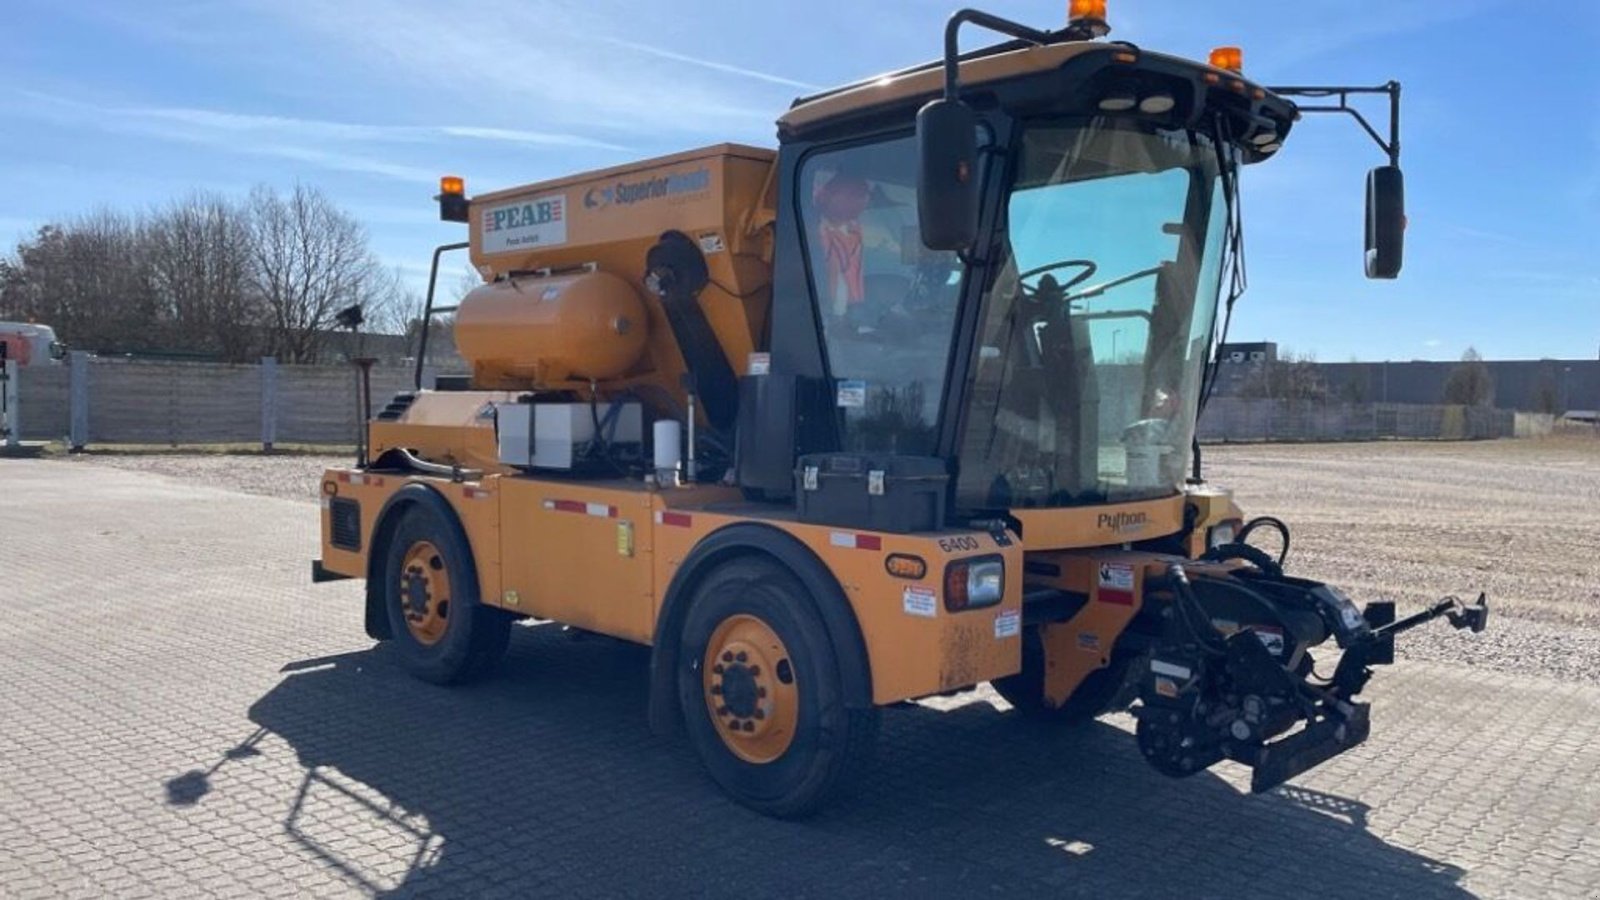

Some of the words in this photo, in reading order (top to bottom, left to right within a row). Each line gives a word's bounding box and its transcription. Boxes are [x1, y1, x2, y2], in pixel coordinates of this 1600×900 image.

[494, 201, 551, 231] PEAB
[1097, 511, 1147, 535] Python
[938, 535, 979, 552] 6400
